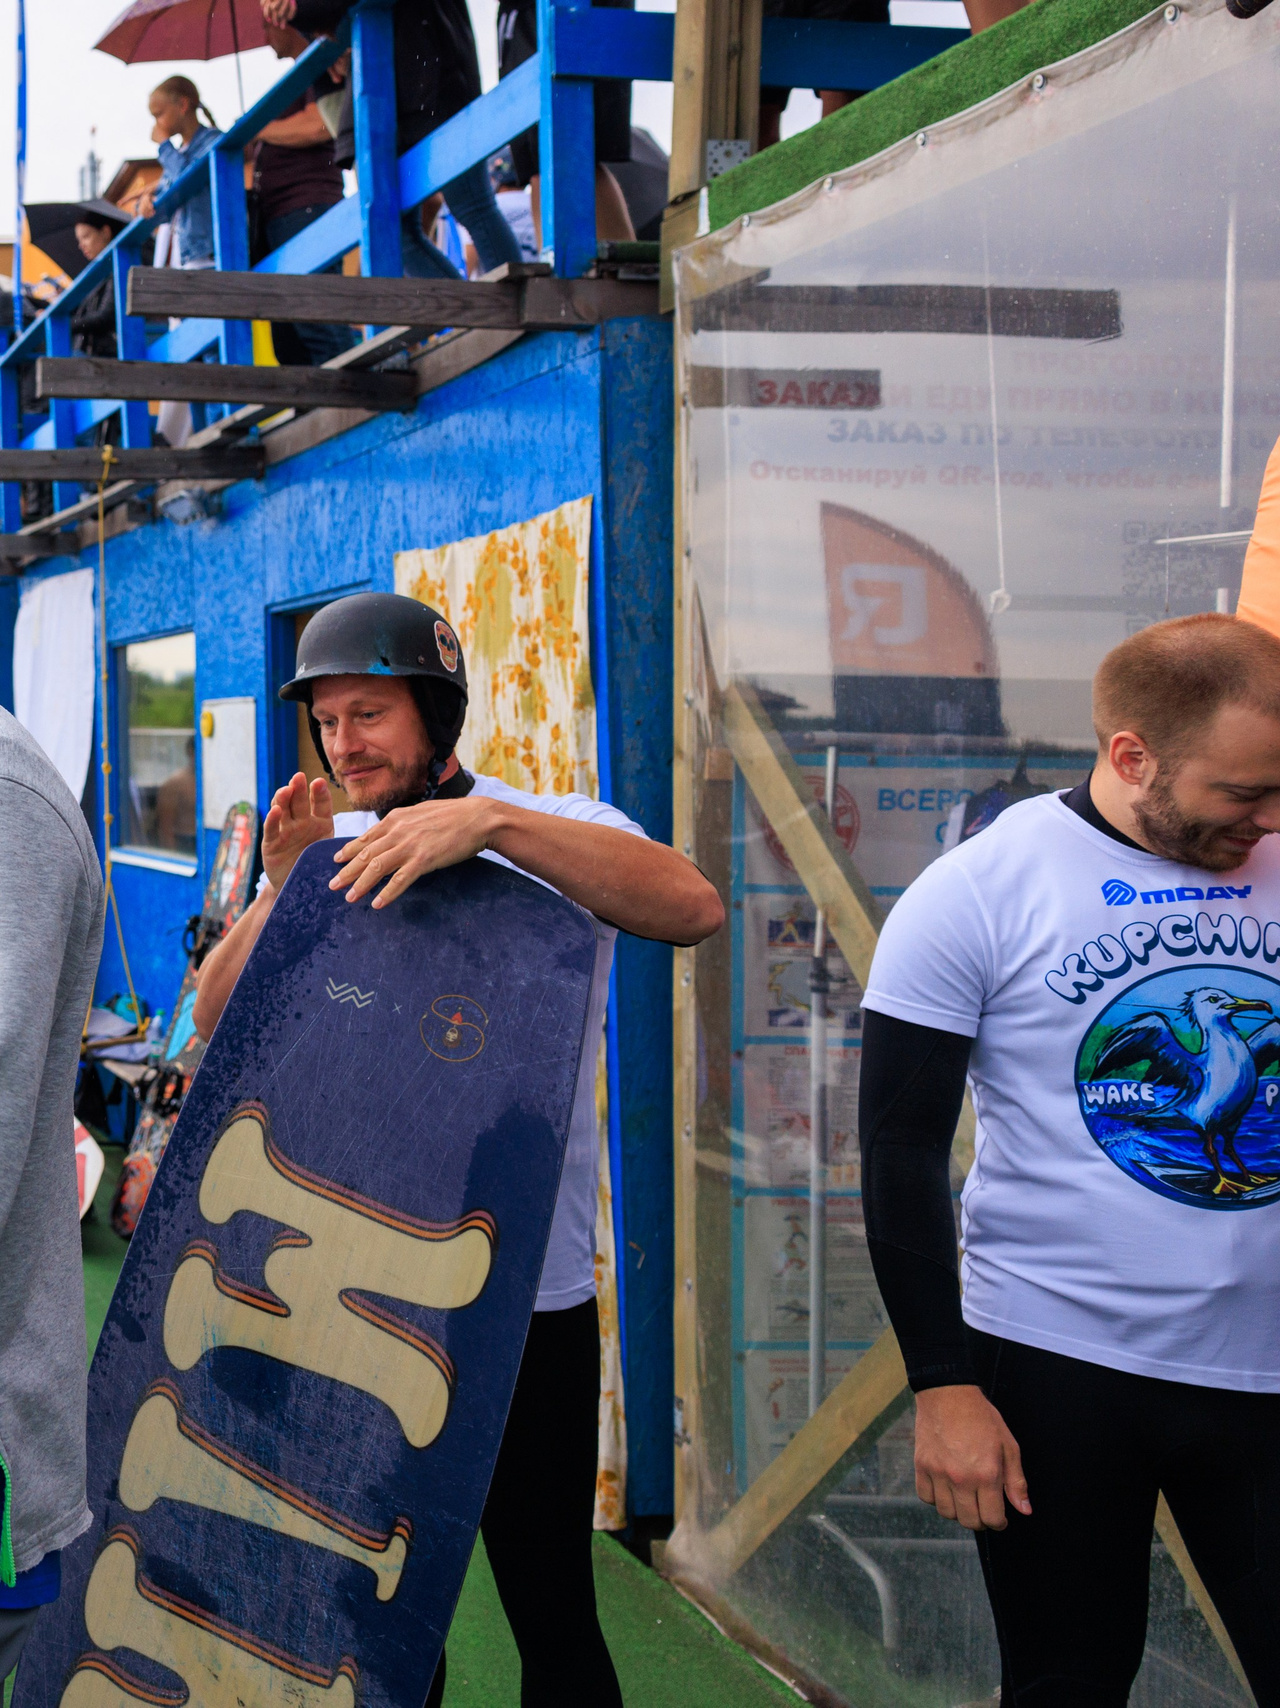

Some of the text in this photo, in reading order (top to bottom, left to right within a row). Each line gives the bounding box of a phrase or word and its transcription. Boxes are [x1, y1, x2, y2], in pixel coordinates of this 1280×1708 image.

[827, 418, 947, 445] ЗАКАЗ
[749, 459, 927, 490] Отсканируй
[1140, 885, 1252, 905] MDAY
[1083, 1083, 1156, 1106] WAKE
